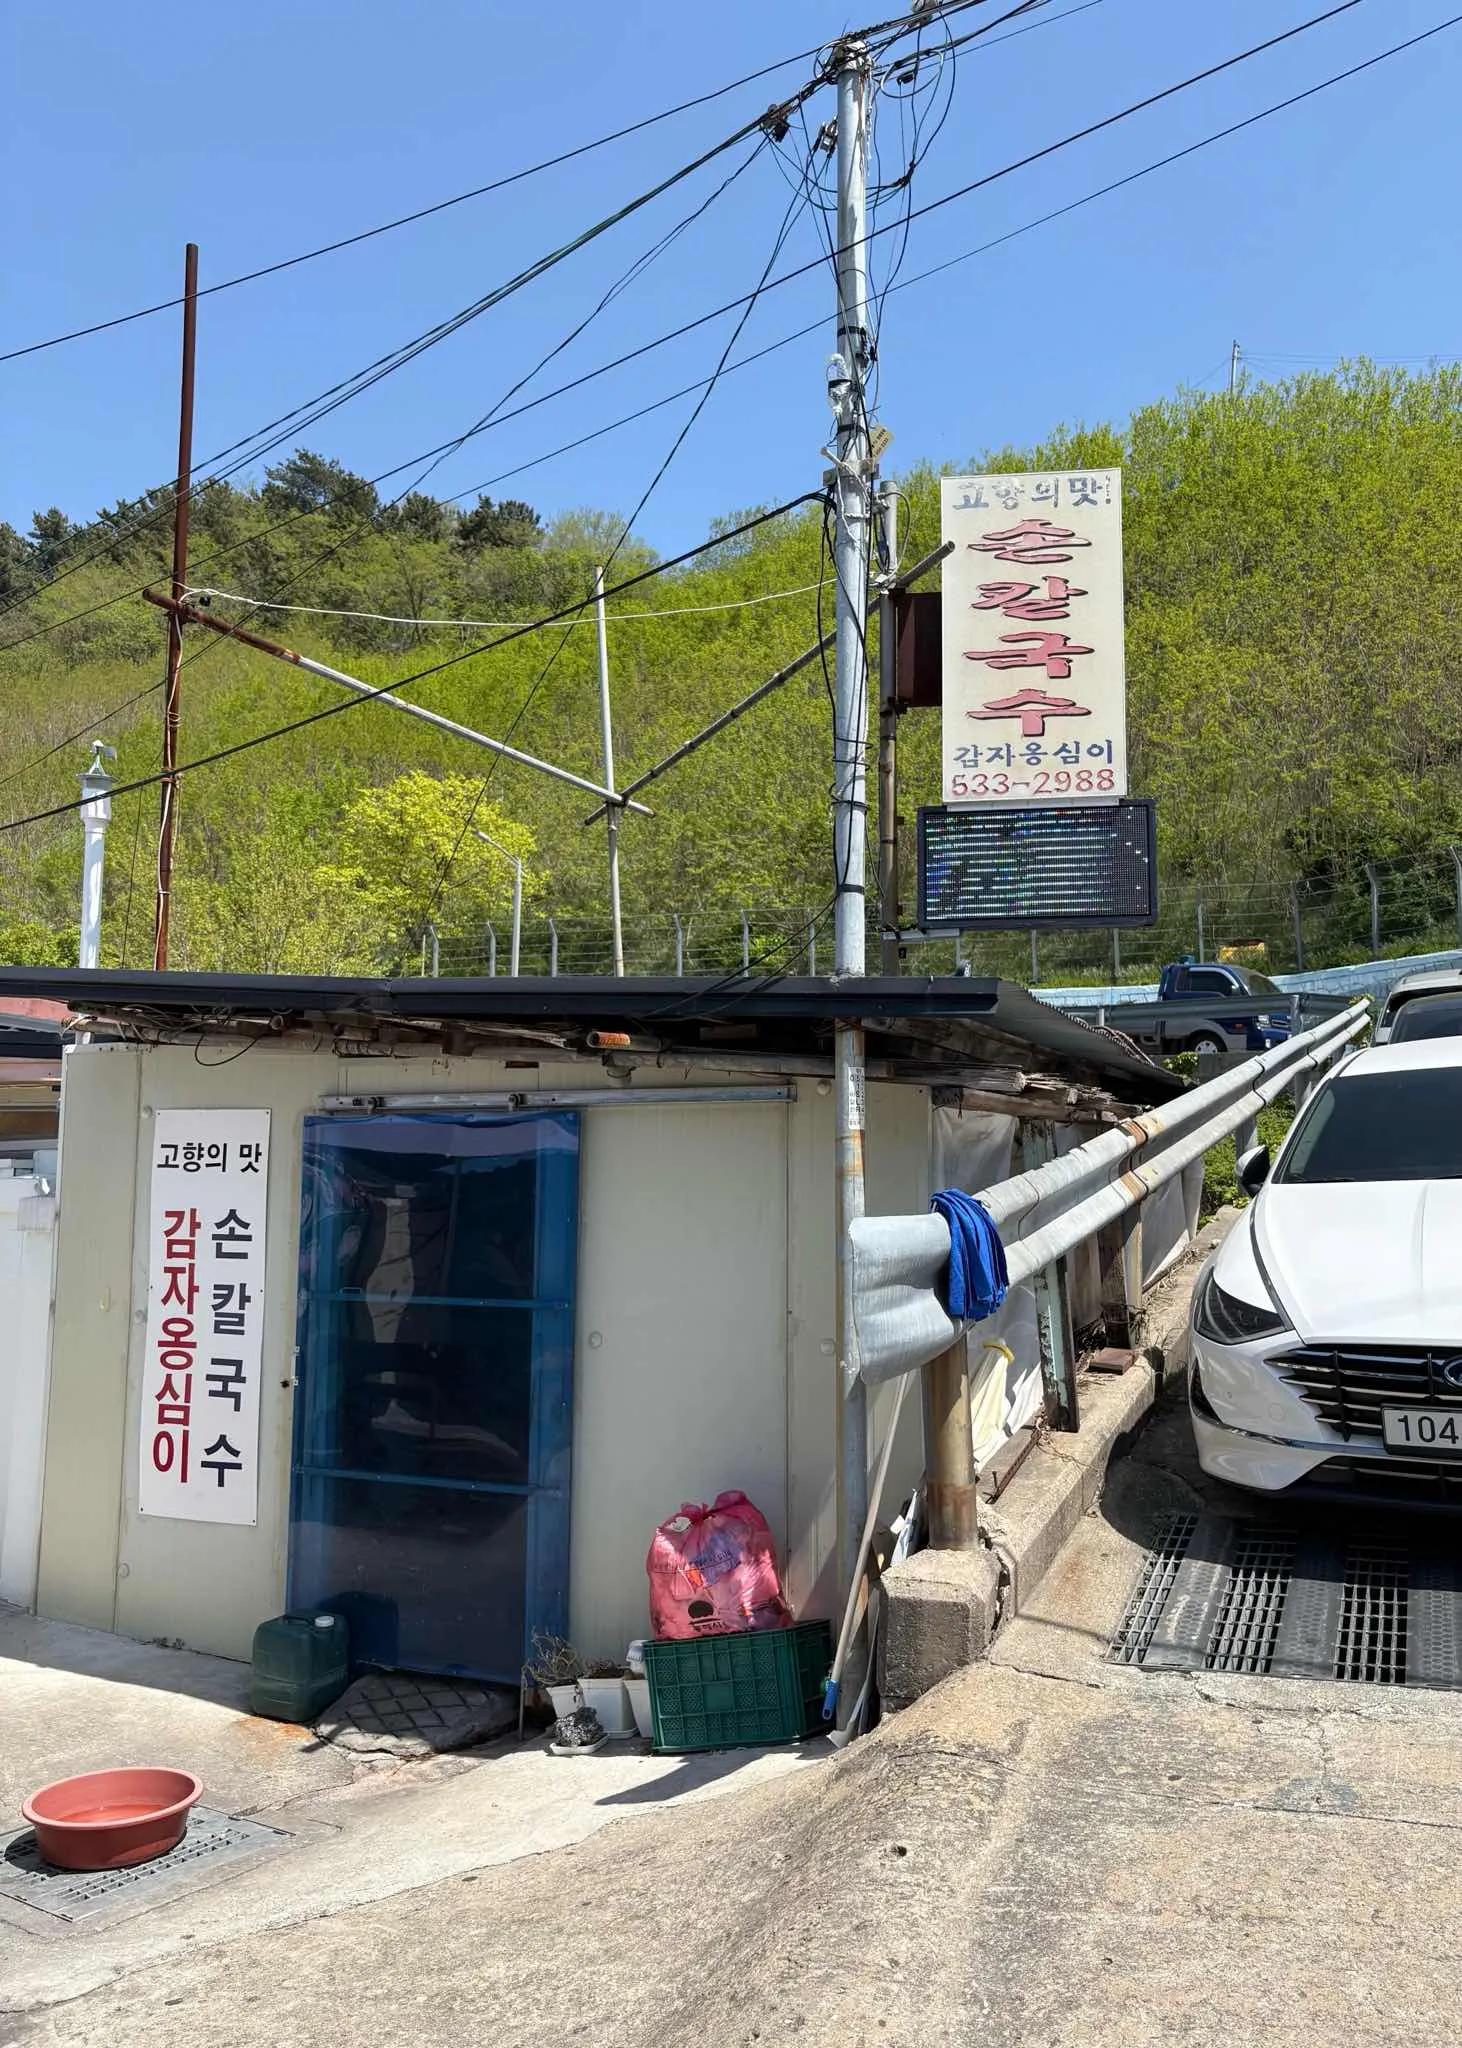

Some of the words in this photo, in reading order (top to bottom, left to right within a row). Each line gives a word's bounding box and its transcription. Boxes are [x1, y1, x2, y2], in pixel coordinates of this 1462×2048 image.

[963, 518, 1095, 737] 손칼국수
[952, 739, 1113, 769] 감자옹심이
[951, 768, 1116, 797] 533-2988
[156, 1141, 228, 1173] 고향의
[239, 1142, 263, 1174] 맛
[151, 1207, 202, 1484] 감자옹심이
[200, 1208, 253, 1488] 손칼국수
[1397, 1414, 1460, 1445] 104
